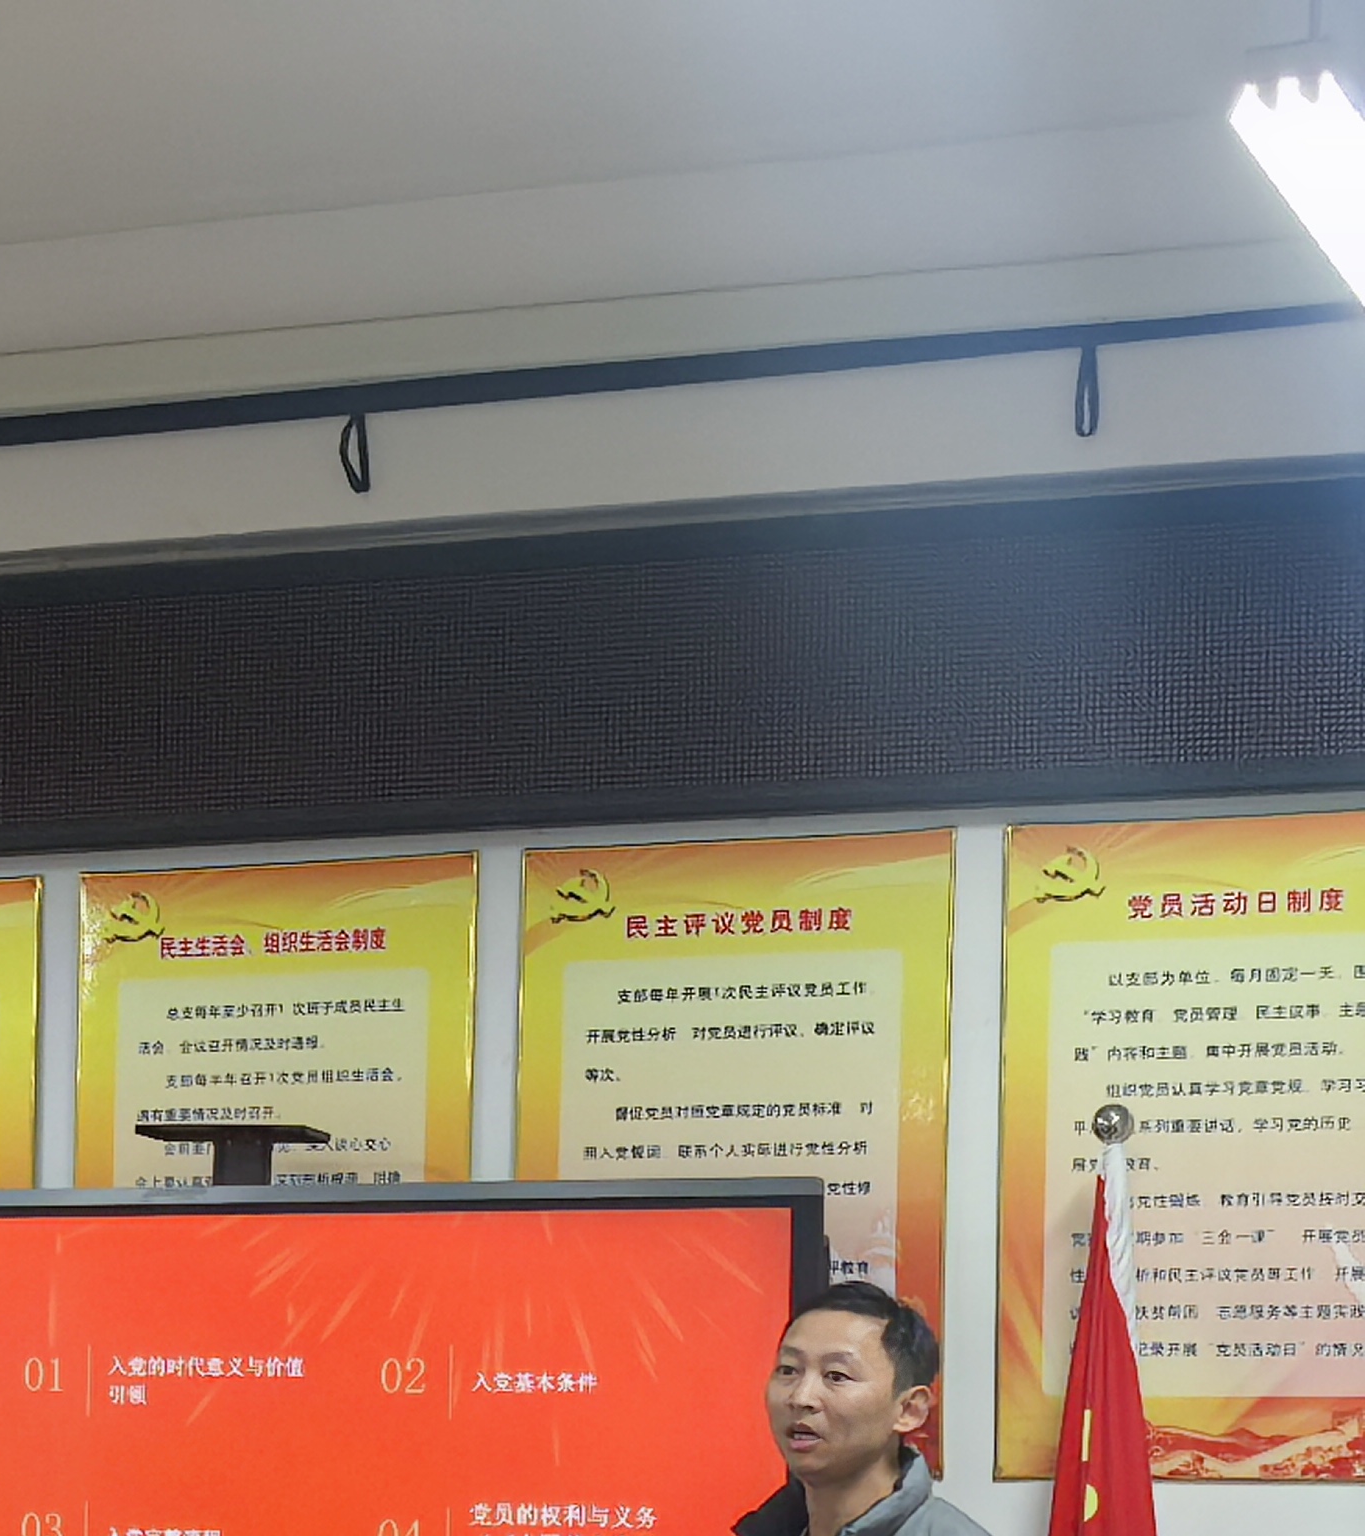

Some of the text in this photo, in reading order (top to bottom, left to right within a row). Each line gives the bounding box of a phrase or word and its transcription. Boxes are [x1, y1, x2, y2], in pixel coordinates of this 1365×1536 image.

[1128, 888, 1345, 919] 党员活动日制度
[626, 907, 852, 939] 民主评议党员制度
[24, 1357, 63, 1392] 01
[108, 1356, 305, 1378] 入党的时代意义与价值
[381, 1358, 426, 1394] 02
[108, 1384, 148, 1406] 引领
[472, 1371, 599, 1393] 入党基本条件
[469, 1502, 658, 1528] 党员的权利与义务
